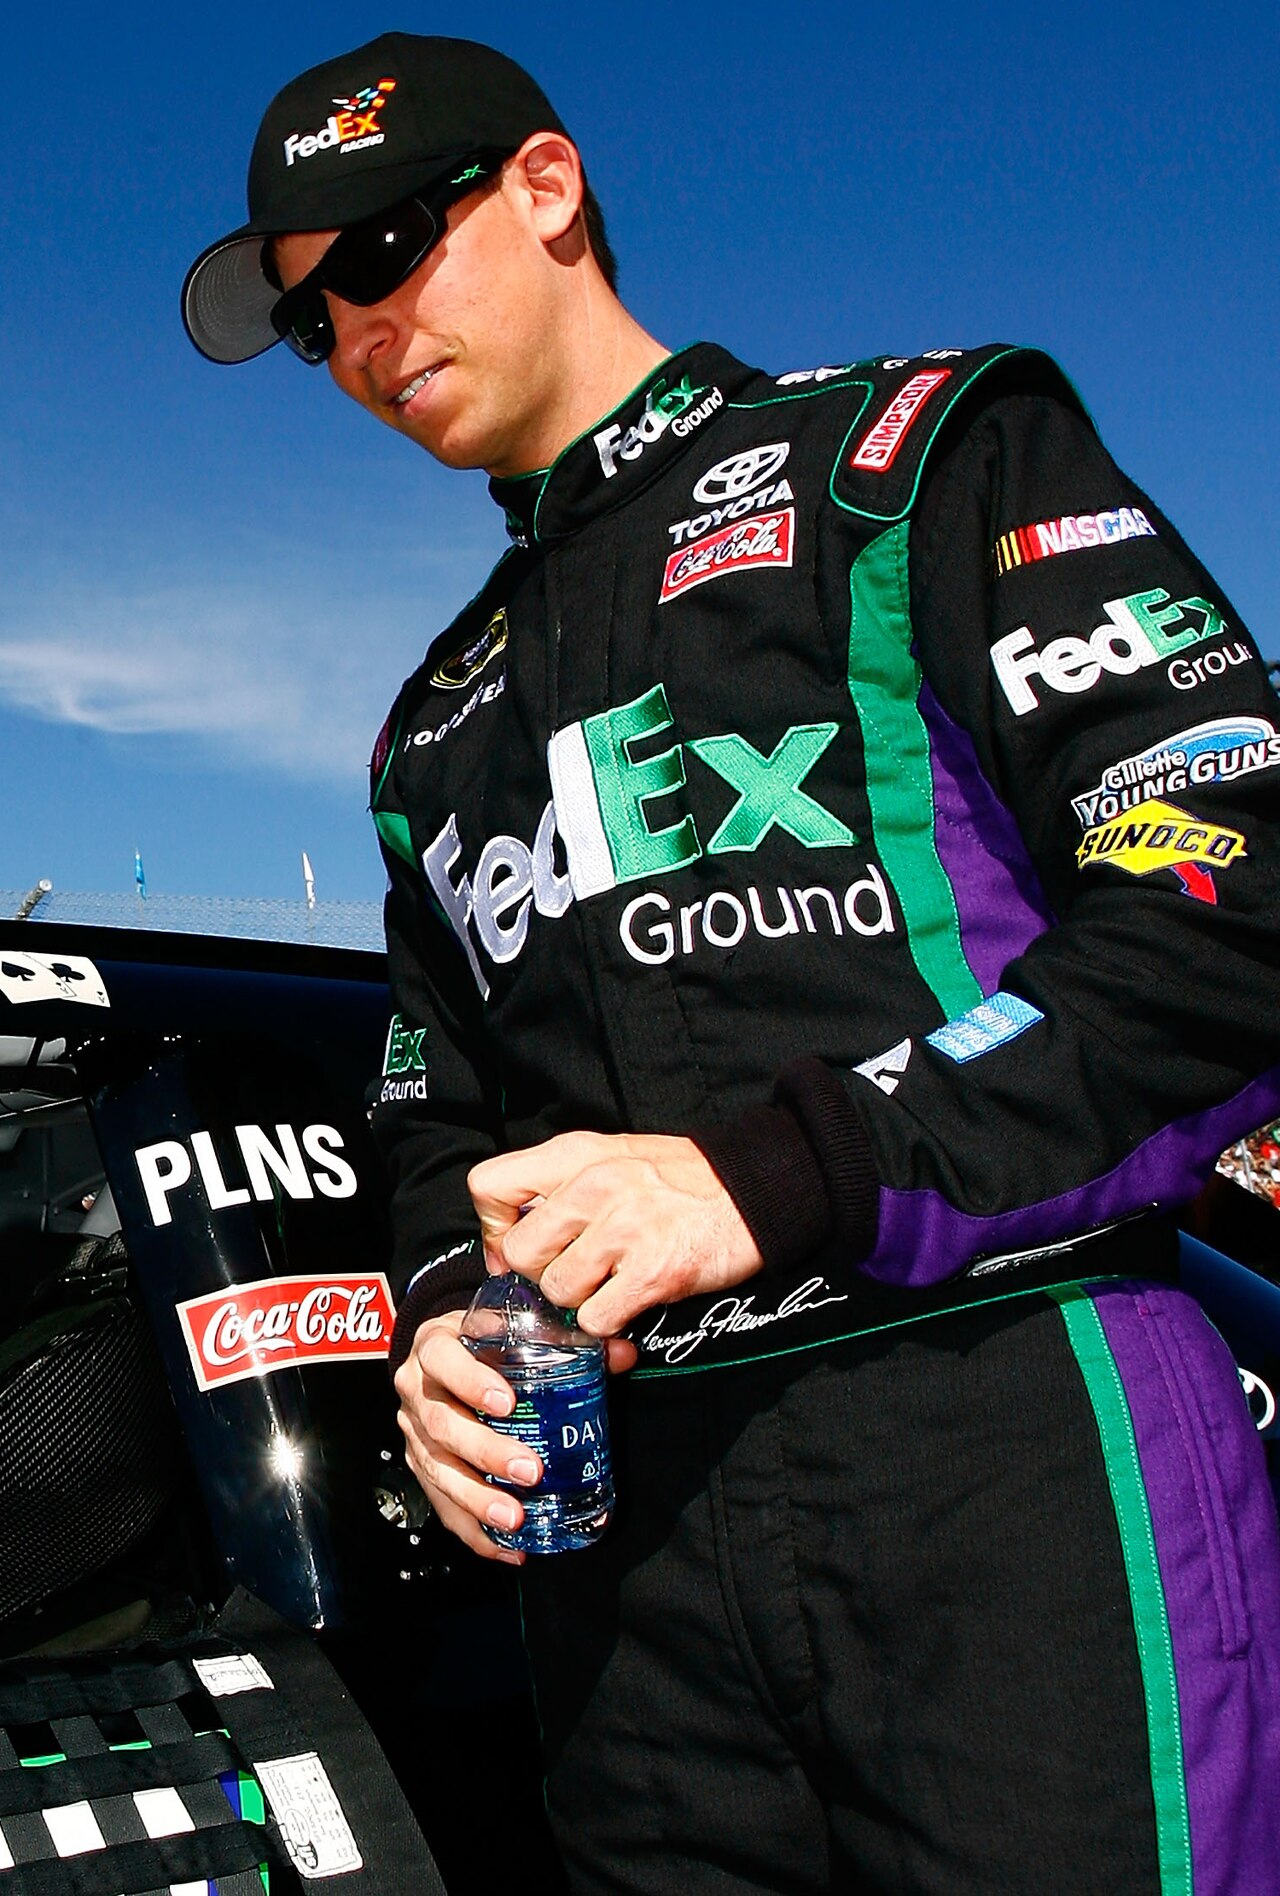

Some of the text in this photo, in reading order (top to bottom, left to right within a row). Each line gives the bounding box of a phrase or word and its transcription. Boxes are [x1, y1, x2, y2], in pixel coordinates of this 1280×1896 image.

[284, 112, 380, 166] FedEx
[340, 133, 385, 154] RACING
[593, 374, 710, 478] FedEx
[671, 387, 723, 437] Ground
[862, 374, 946, 460] SIMPSON
[669, 479, 794, 545] TOYOTA
[1035, 507, 1158, 557] NASCAR
[990, 588, 1229, 716] FedEx
[1077, 739, 1280, 826] YOUNG GUNS
[1106, 750, 1187, 790] Gillette
[422, 683, 859, 1000] FedEx
[1081, 823, 1238, 864] SUNOCO
[619, 863, 896, 965] Ground
[134, 1123, 358, 1227] PLNS
[201, 1285, 383, 1367] Coca-Cola
